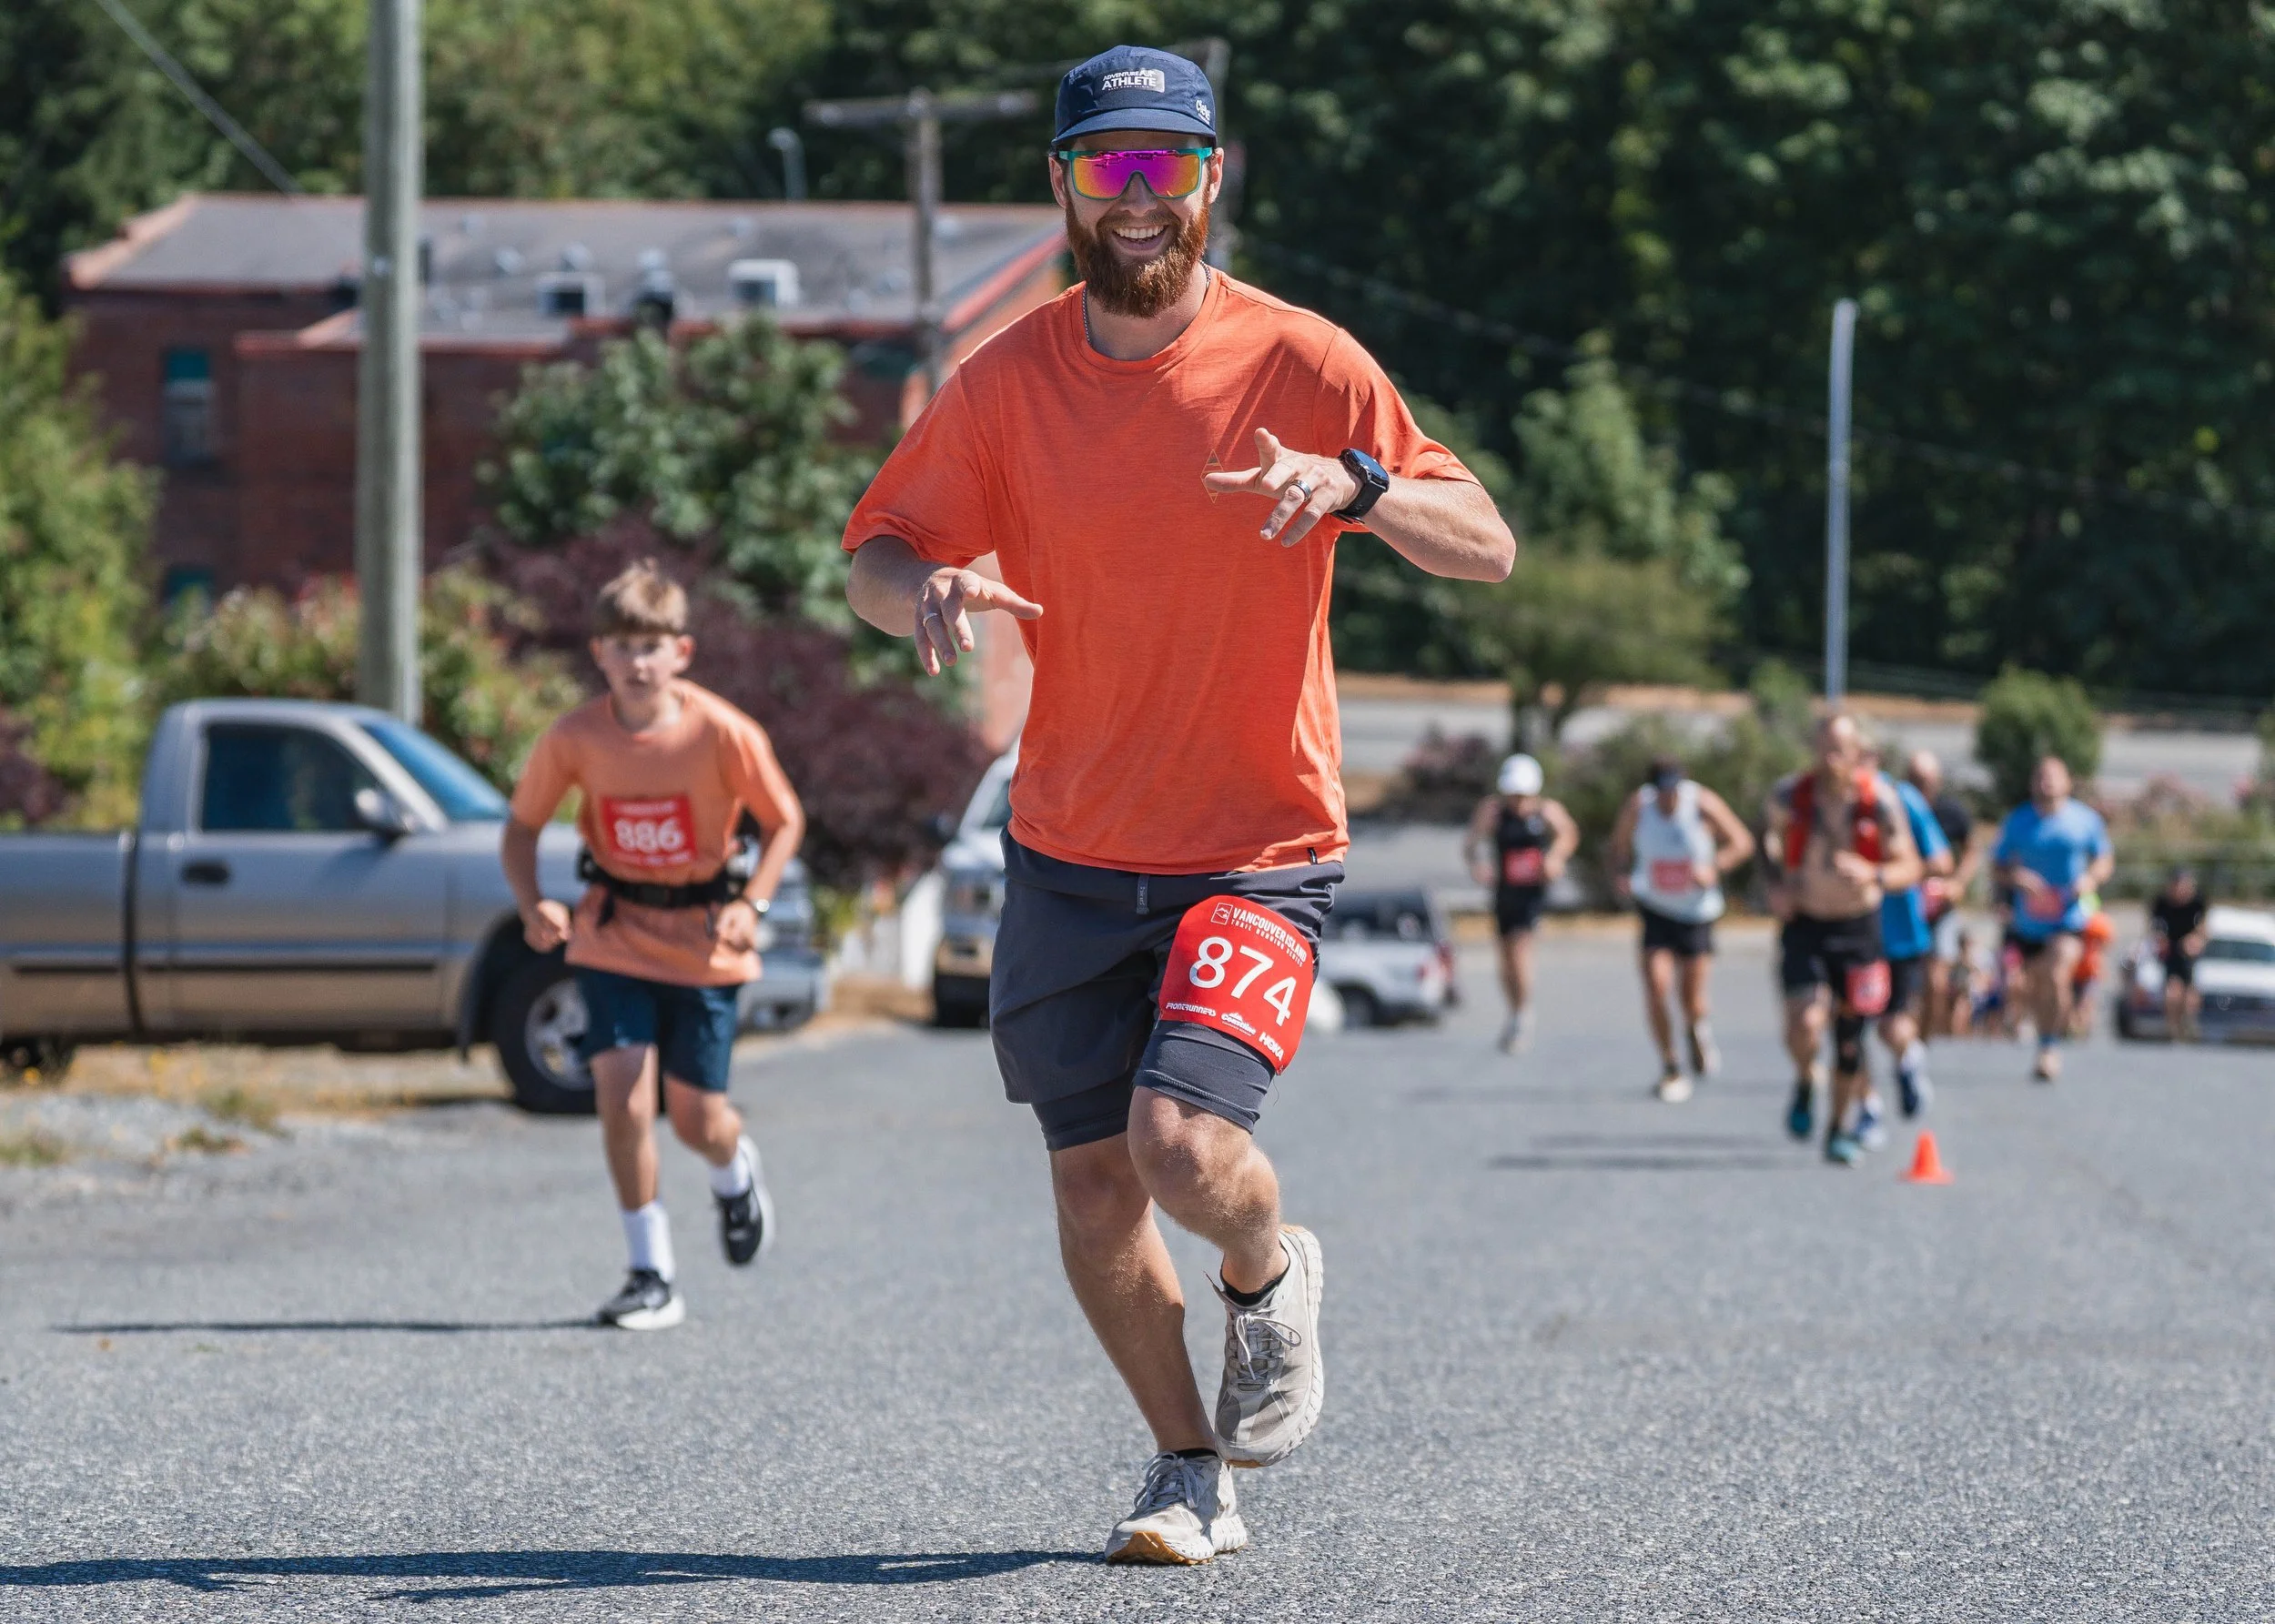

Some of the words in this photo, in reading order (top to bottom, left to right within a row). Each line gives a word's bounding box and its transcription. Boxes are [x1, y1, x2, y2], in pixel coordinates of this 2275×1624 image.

[1101, 76, 1157, 91] ATHLETE
[1102, 71, 1139, 82] ADVENTURE
[613, 817, 685, 853] 886
[1230, 919, 1252, 932] TRAIL
[1255, 929, 1285, 950] RUNNING
[1232, 907, 1287, 943] VANCOUVER
[1285, 933, 1308, 963] ISLAND
[1189, 936, 1297, 1027] 874
[1258, 1031, 1285, 1062] HOKA
